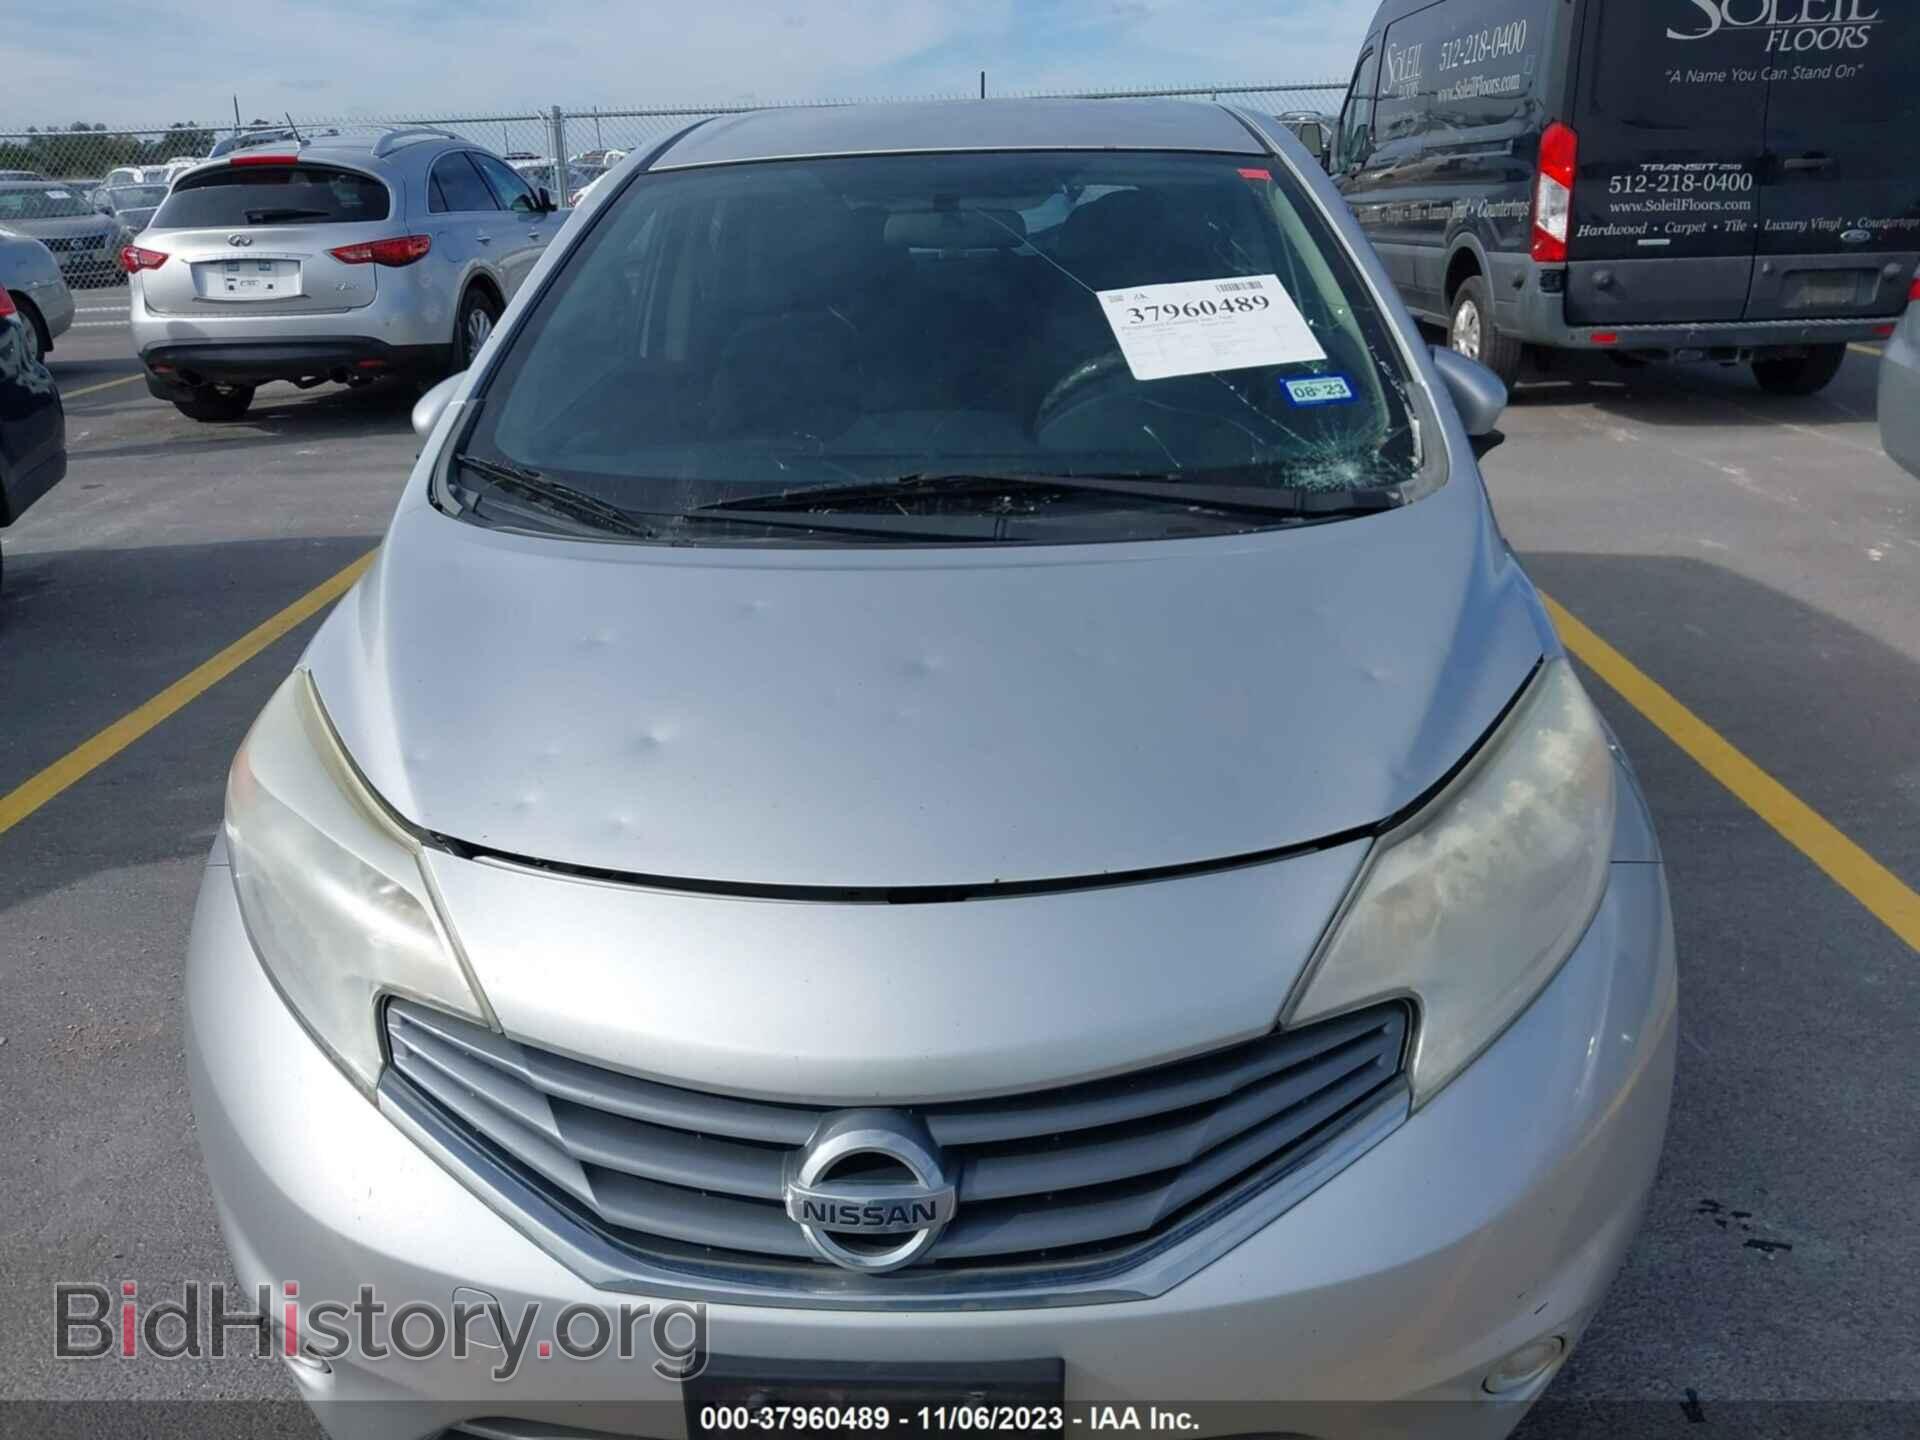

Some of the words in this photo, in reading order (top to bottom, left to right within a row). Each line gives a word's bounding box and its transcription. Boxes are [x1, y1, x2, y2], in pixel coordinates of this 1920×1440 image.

[1439, 19, 1527, 72] 512-218-0400
[1764, 25, 1872, 52] FLOORS
[1685, 69, 1726, 83] Name
[1731, 67, 1756, 82] You
[1761, 66, 1787, 81] Can
[1791, 64, 1831, 80] Stand
[1640, 163, 1718, 172] TRANSIT
[1608, 172, 1752, 194] 512-218-0400
[1609, 199, 1751, 213] www.SoleilFloors.com
[1577, 222, 1647, 238] Hardwood
[1664, 220, 1707, 235] Carpet
[1724, 219, 1748, 233] Tile
[1764, 218, 1808, 233] Luxury
[1810, 216, 1842, 231] Vinyl
[1127, 294, 1270, 324] 37960489
[803, 1200, 937, 1226] NISSAN
